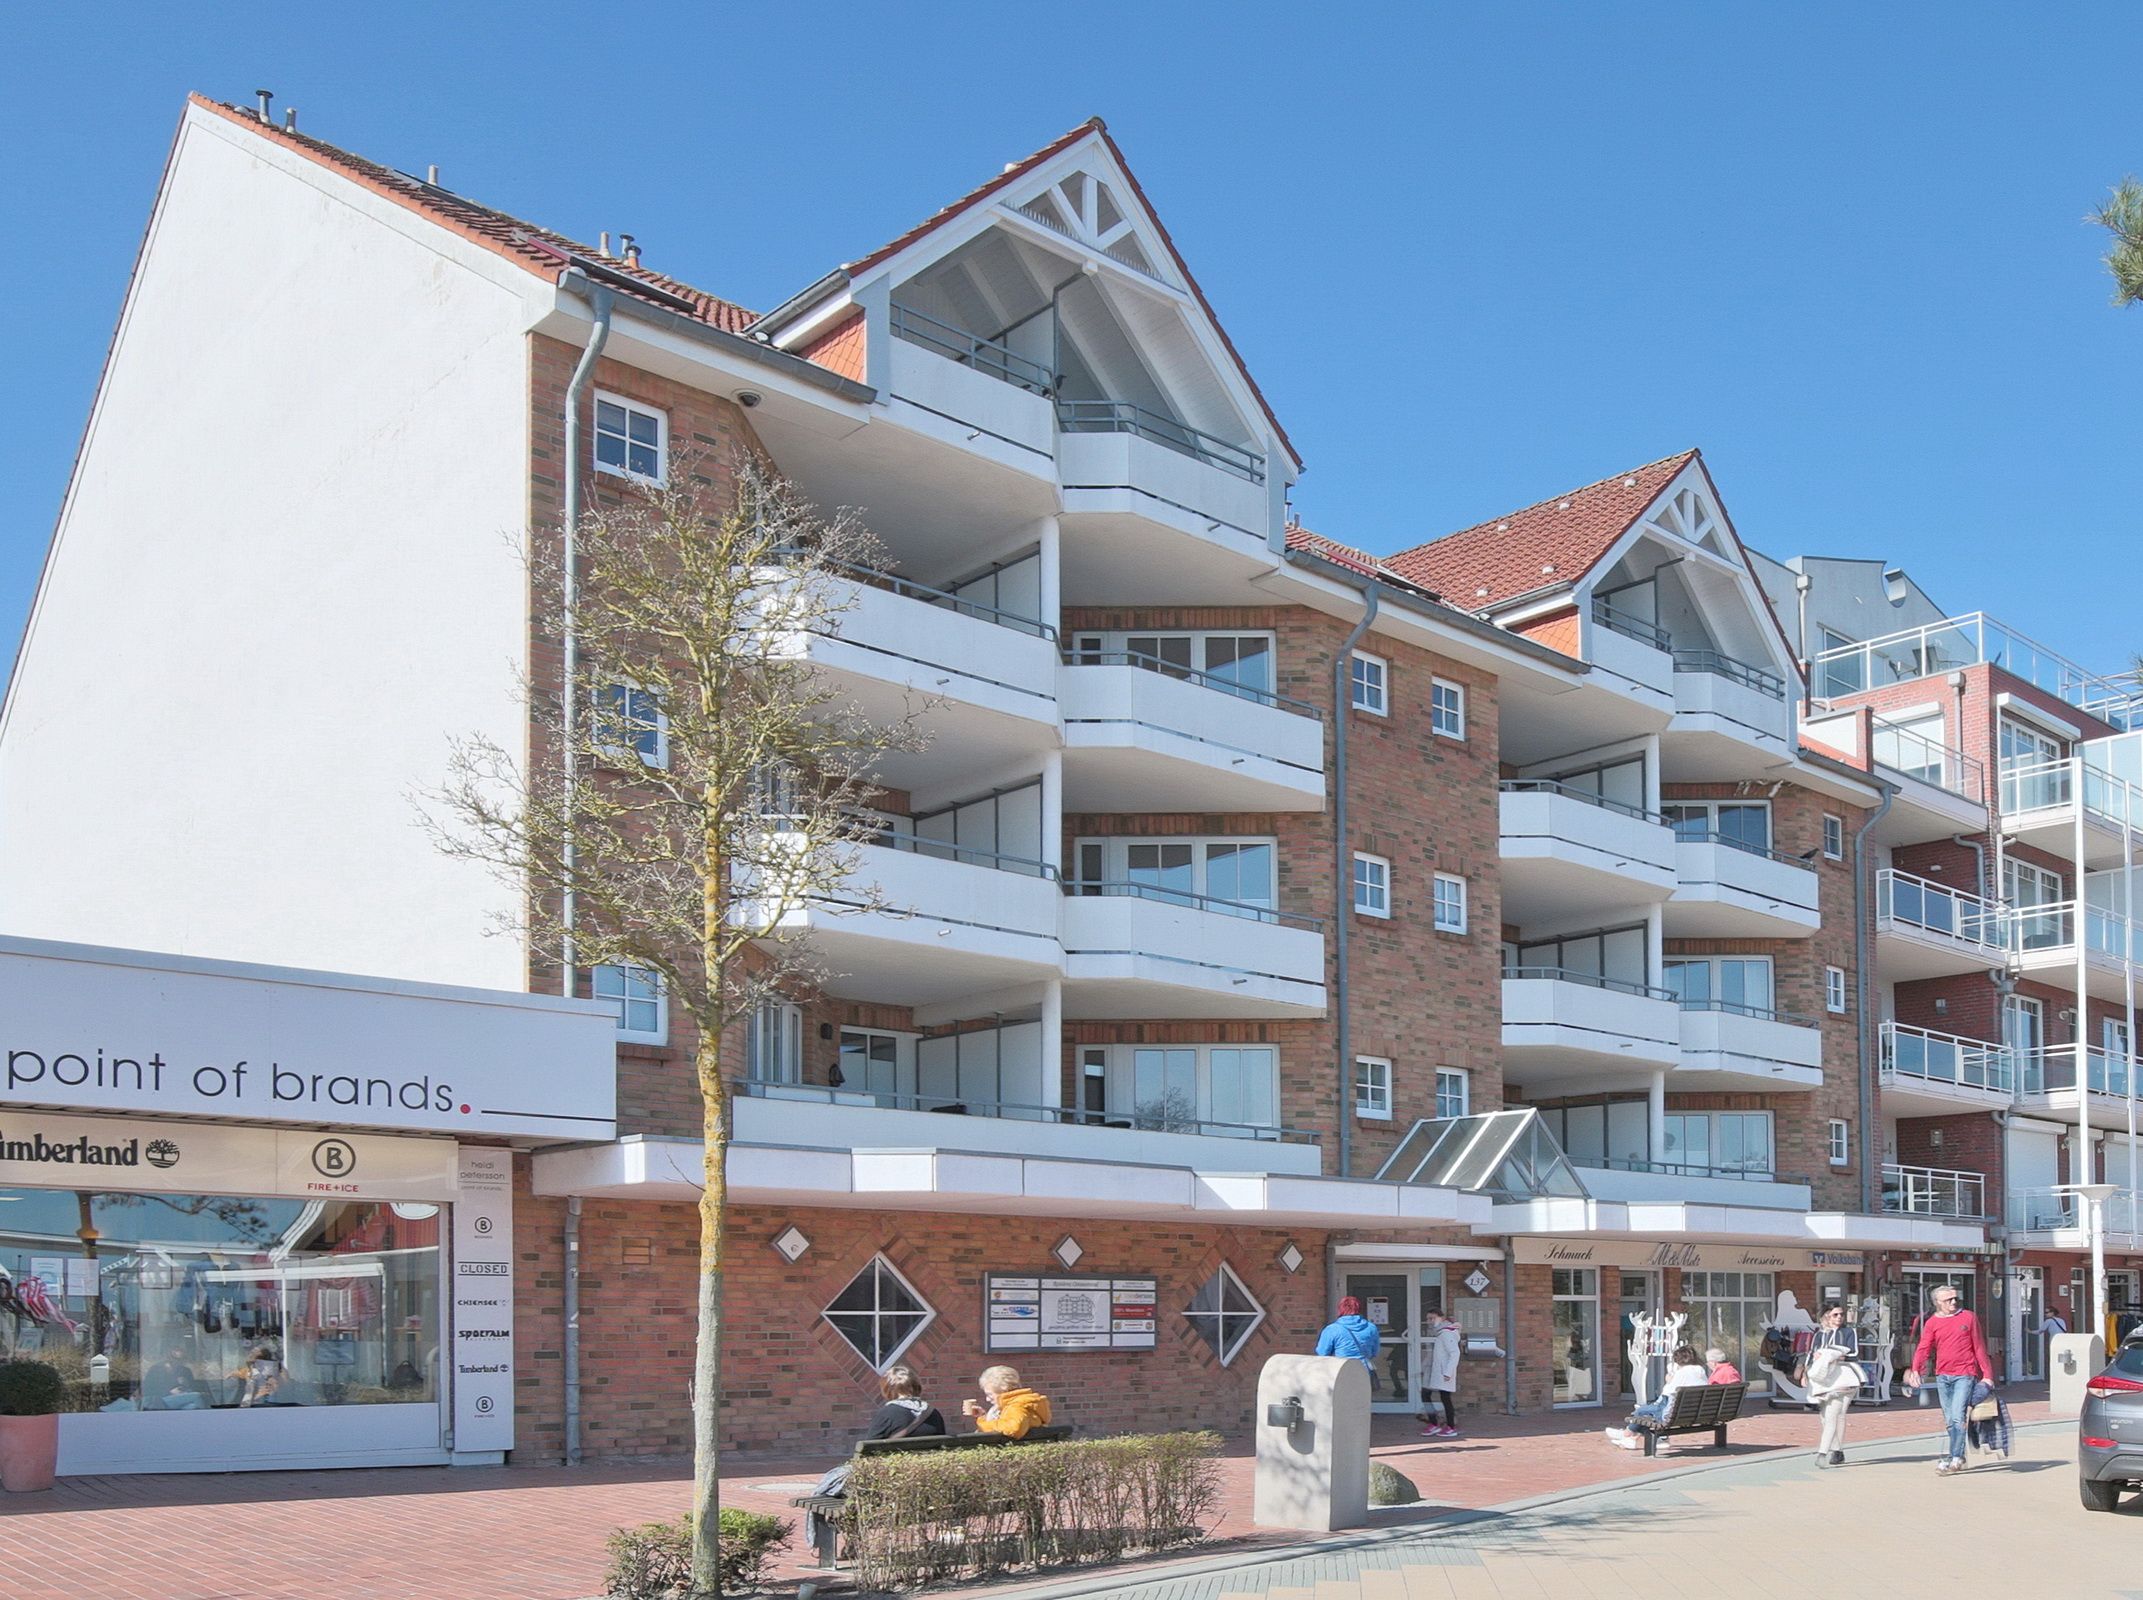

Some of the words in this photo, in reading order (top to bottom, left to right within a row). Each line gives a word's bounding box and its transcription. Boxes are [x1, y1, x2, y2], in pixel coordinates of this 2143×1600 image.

[8, 1048, 166, 1091] point
[193, 1061, 248, 1097] of
[0, 1131, 139, 1166] imberland
[471, 1161, 495, 1169] heidi
[1544, 1244, 1593, 1261] Schmuck
[460, 1264, 508, 1274] CLOSED
[1469, 1277, 1486, 1287] 137
